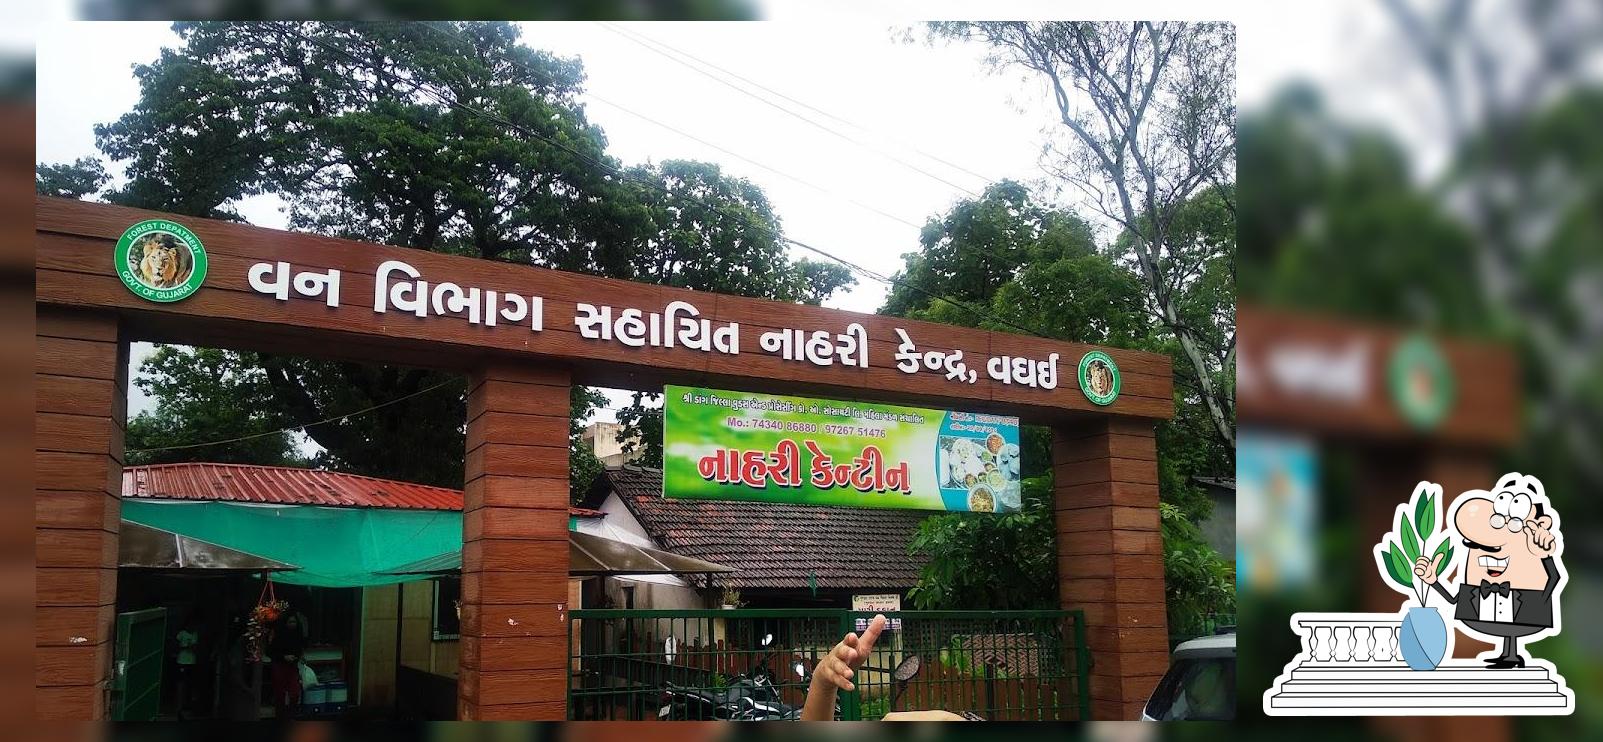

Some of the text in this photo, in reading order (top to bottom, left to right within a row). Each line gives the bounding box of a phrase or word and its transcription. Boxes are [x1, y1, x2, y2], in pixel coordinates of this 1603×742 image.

[127, 223, 201, 254] FOREST DEPATMENT
[122, 270, 193, 299] GOVT. OF GUJARAT
[247, 260, 341, 308] વન
[373, 259, 543, 331] વિભાગ
[575, 300, 740, 355] સહાયિત
[759, 322, 869, 369] નાહરી
[986, 353, 1059, 390] વઘઈ
[727, 417, 886, 438] Mo.: 74340 86880 97267 51476
[698, 439, 911, 493] નાહરી કેન્ટીન
